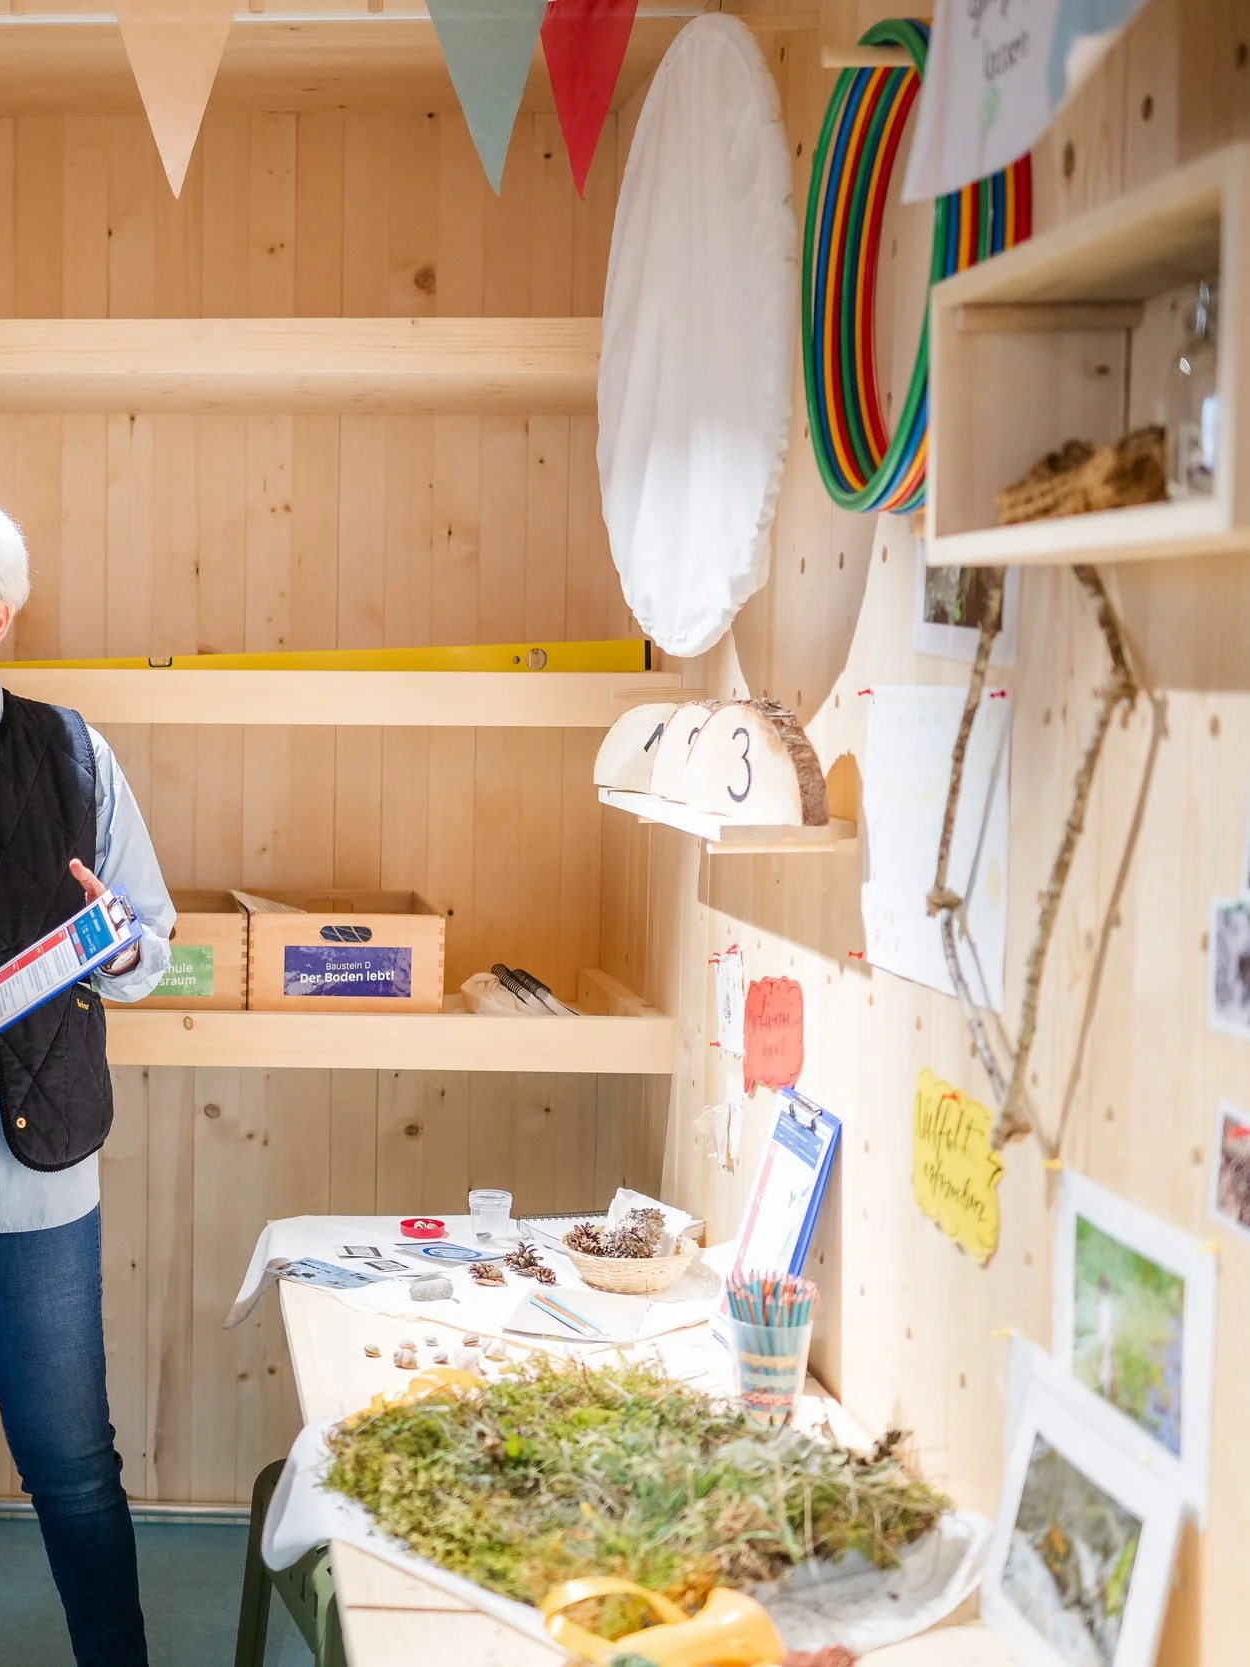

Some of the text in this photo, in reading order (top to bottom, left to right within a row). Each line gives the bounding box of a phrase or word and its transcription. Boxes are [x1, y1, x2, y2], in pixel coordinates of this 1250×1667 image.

[727, 727, 751, 803] 3
[167, 962, 194, 974] hule
[325, 961, 371, 971] Baustein D
[159, 976, 196, 986] sraum
[300, 970, 395, 983] Der Boden lebt!
